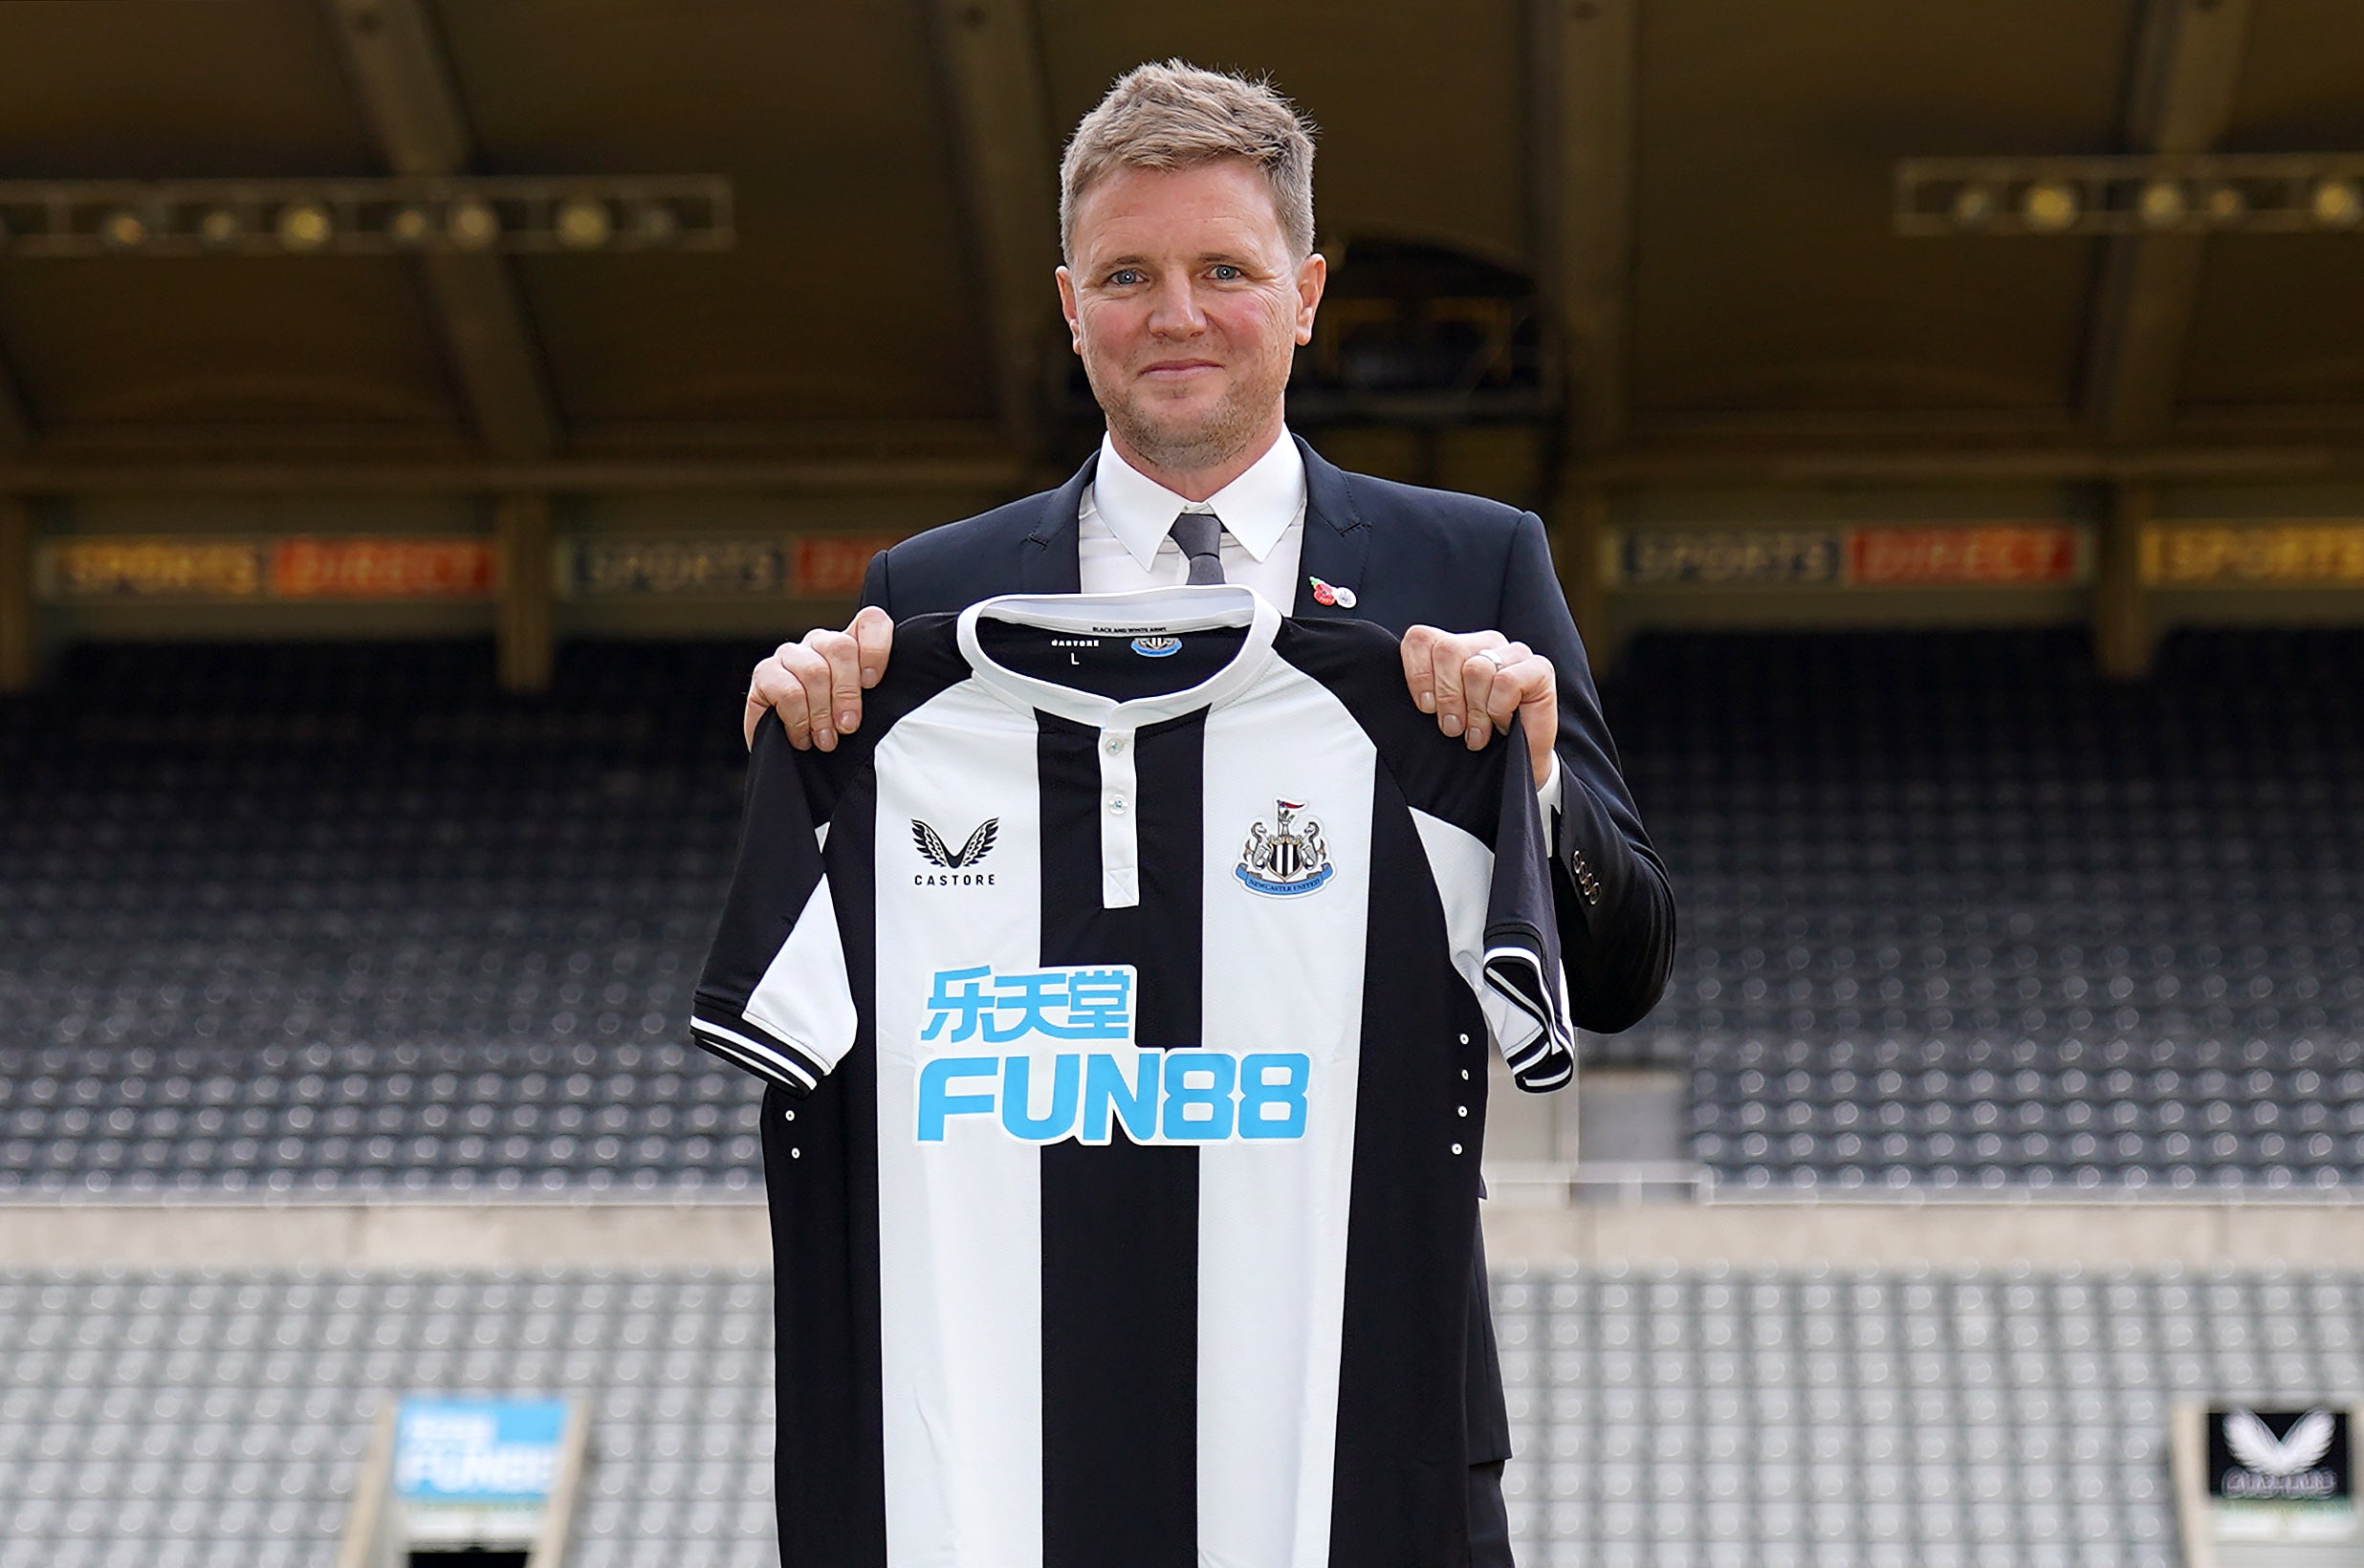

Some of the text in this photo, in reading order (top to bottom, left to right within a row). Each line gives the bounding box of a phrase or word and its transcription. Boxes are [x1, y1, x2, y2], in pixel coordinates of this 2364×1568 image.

[1070, 652, 1080, 665] L
[914, 874, 996, 886] CASTORE
[1248, 878, 1320, 892] NEWCASTLE UNITED
[921, 965, 1130, 1043] 乐天堂
[917, 1053, 1311, 1142] FUN88
